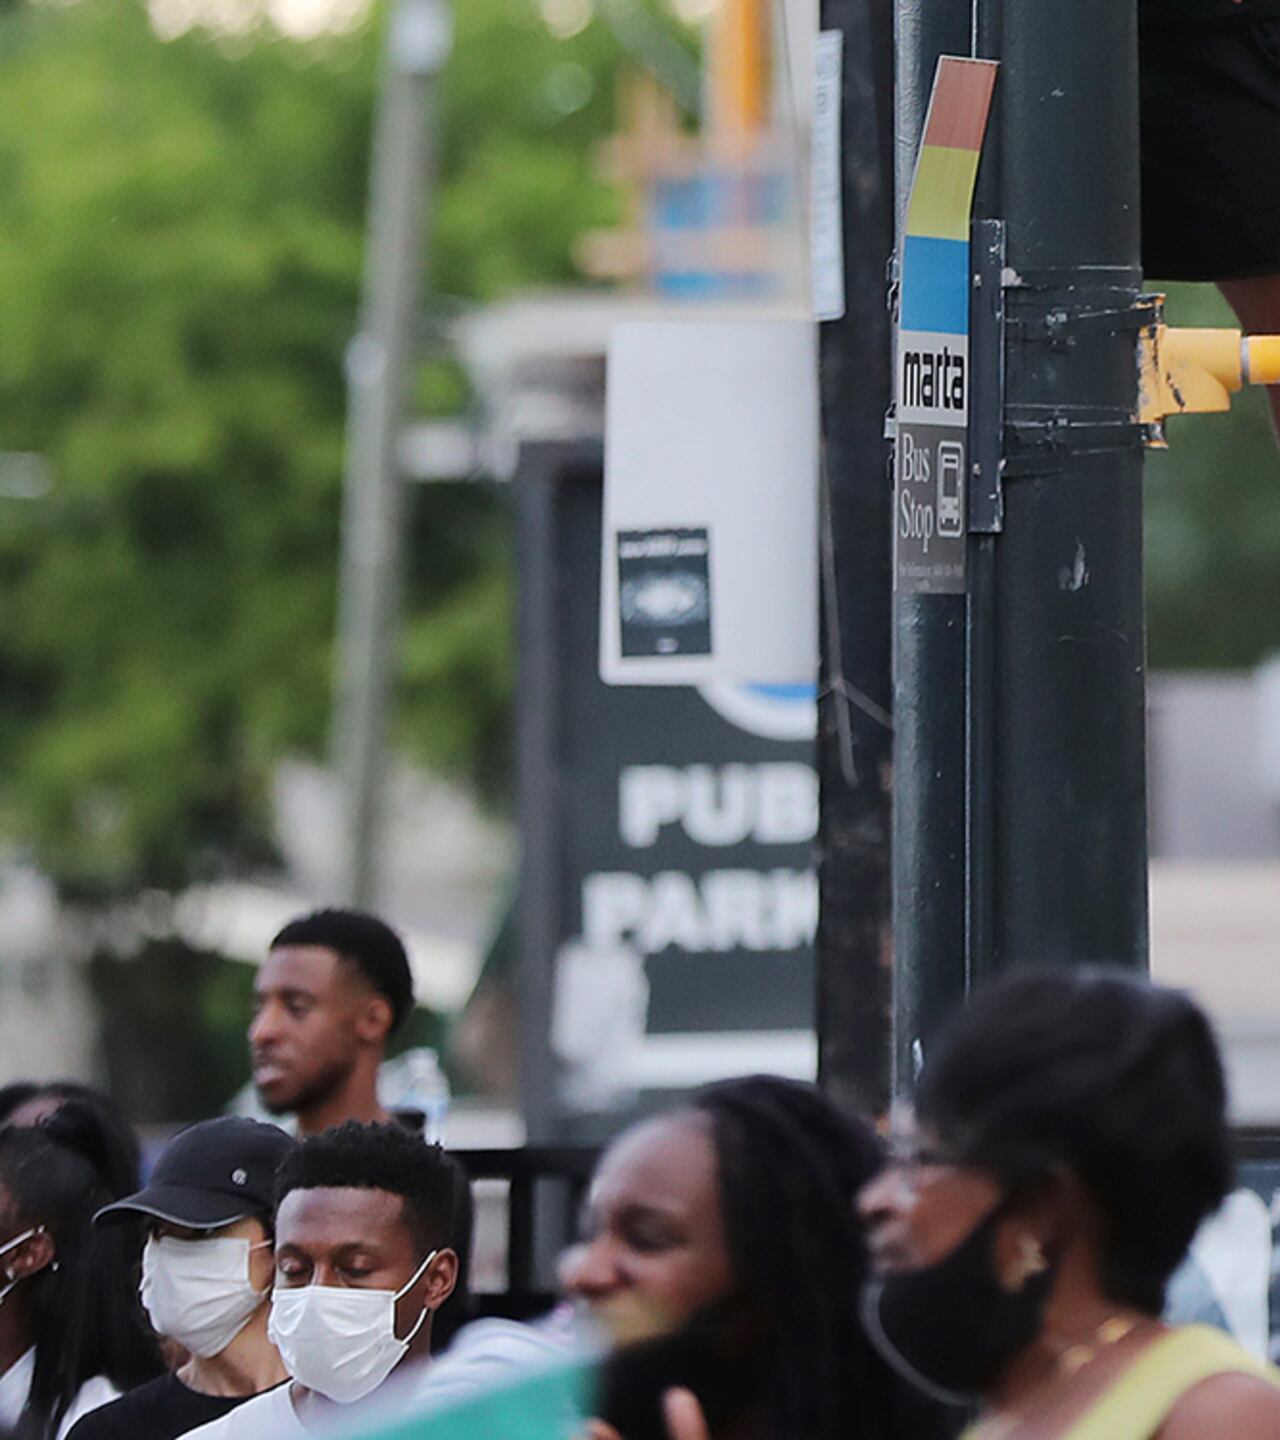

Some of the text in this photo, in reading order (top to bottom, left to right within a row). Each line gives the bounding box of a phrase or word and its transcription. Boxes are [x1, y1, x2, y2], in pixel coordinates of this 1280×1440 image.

[904, 347, 965, 411] marta
[902, 432, 931, 484] Bus
[900, 488, 935, 554] Stop
